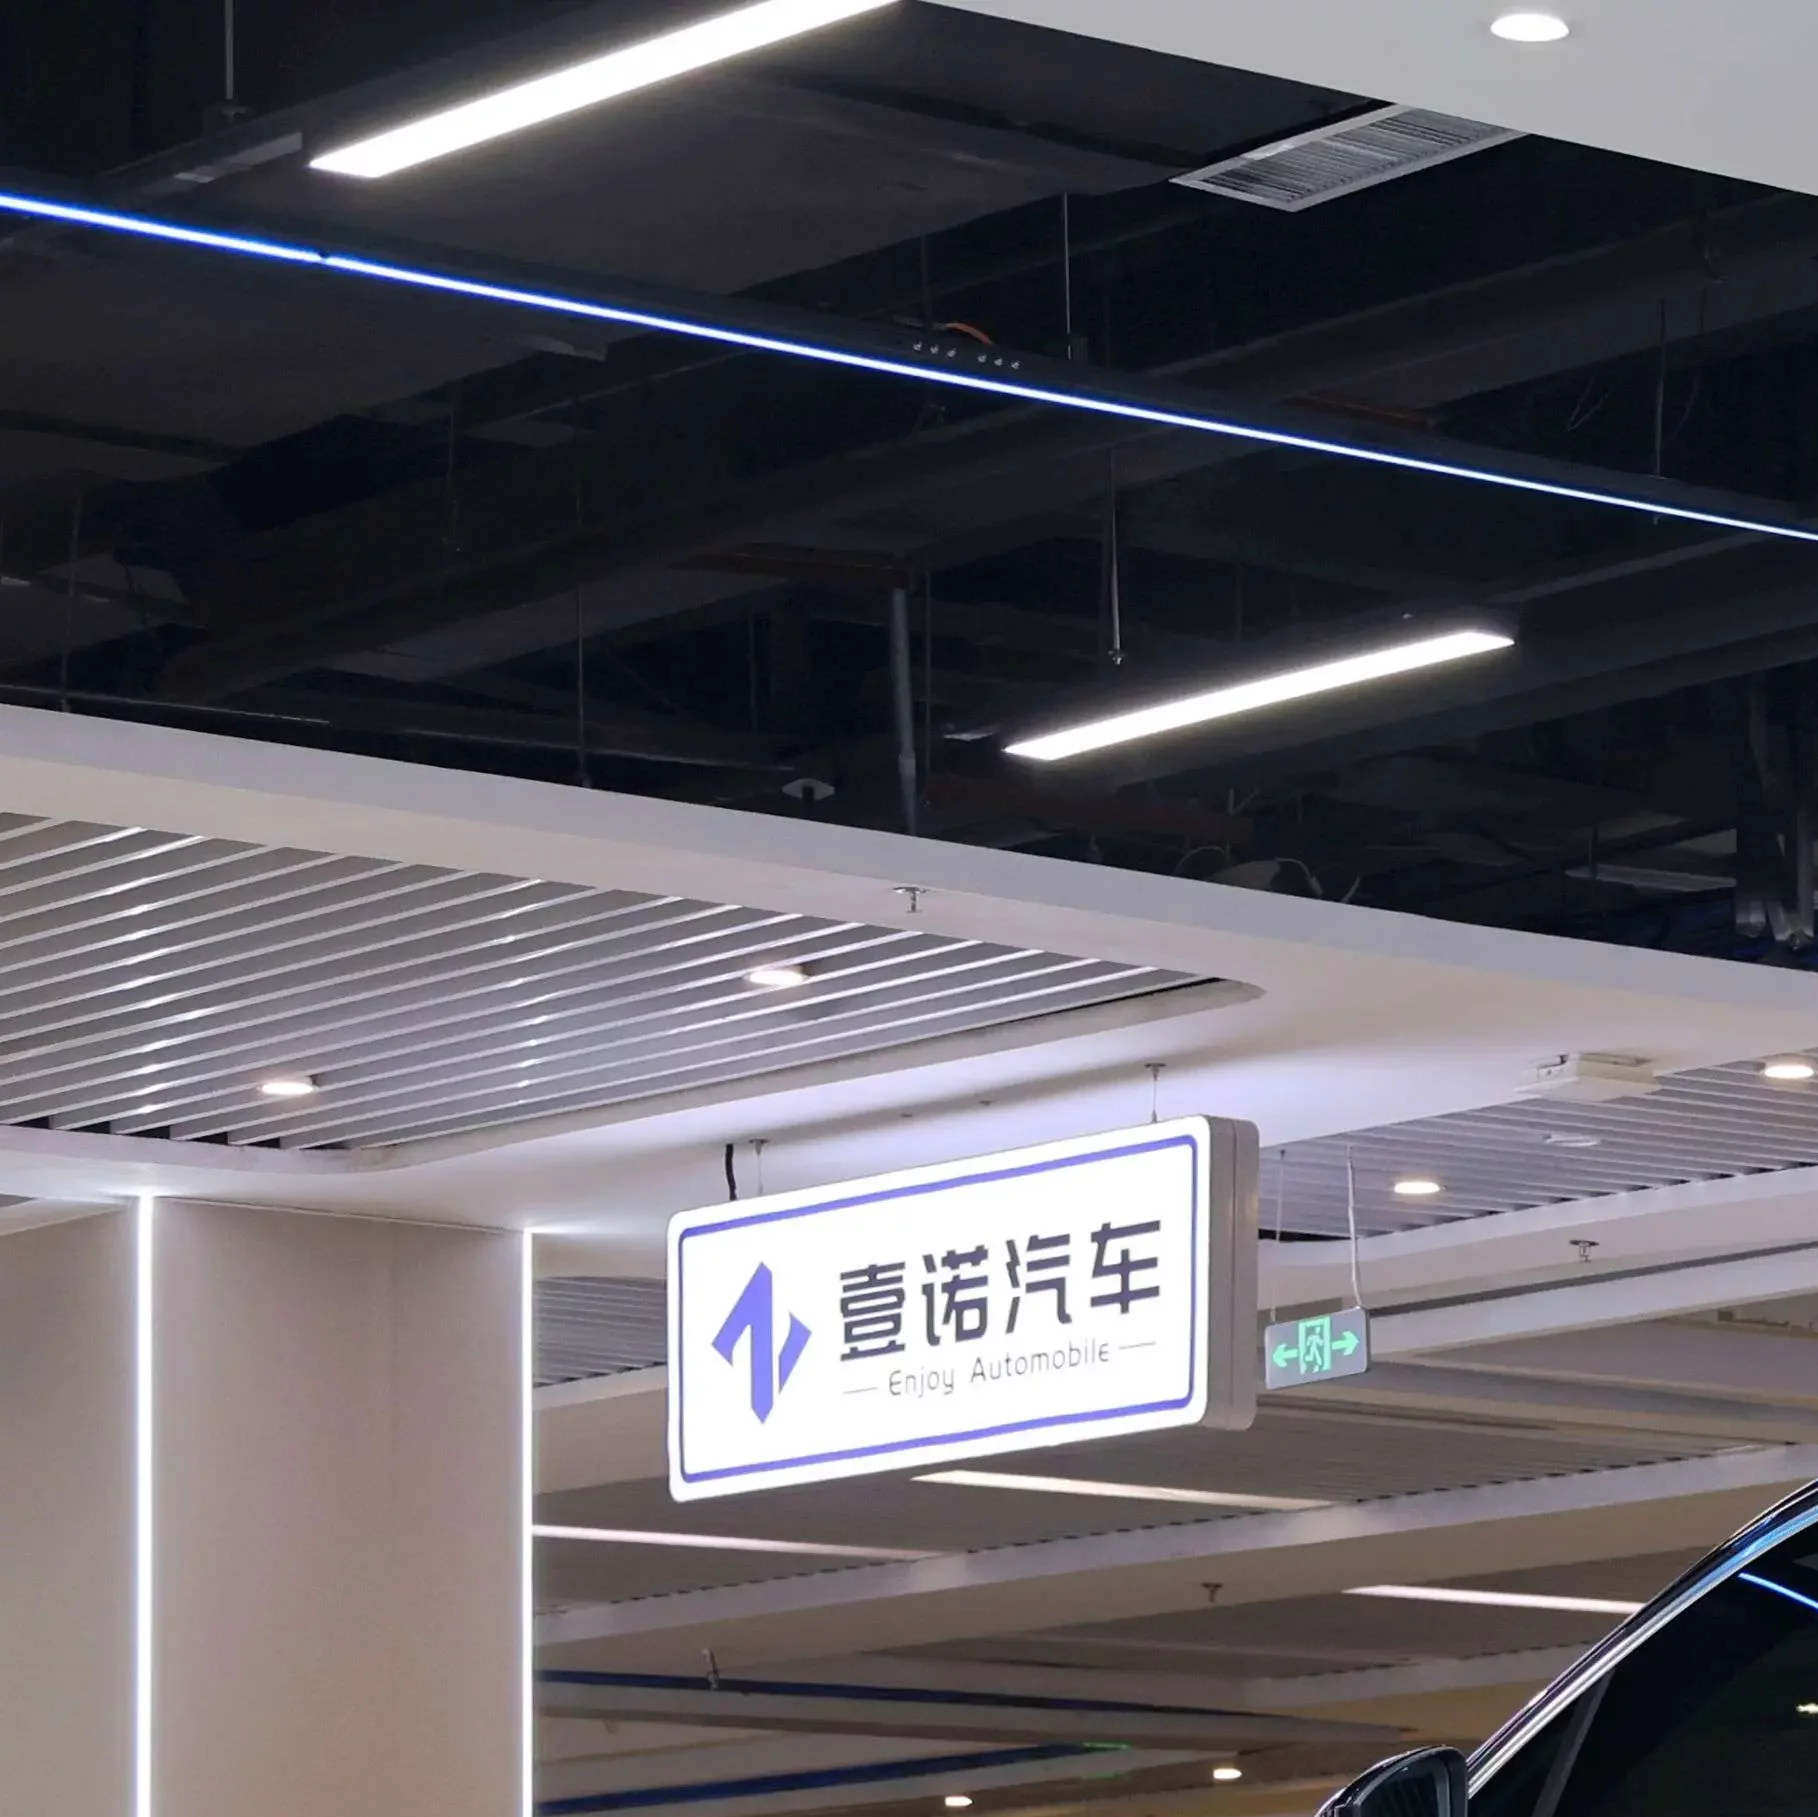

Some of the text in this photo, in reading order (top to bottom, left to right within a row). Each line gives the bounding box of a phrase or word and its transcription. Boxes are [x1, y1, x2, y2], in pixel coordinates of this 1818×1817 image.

[840, 1220, 1160, 1361] 壹诺汽车
[889, 1338, 1110, 1398] Enjoy Automobile
